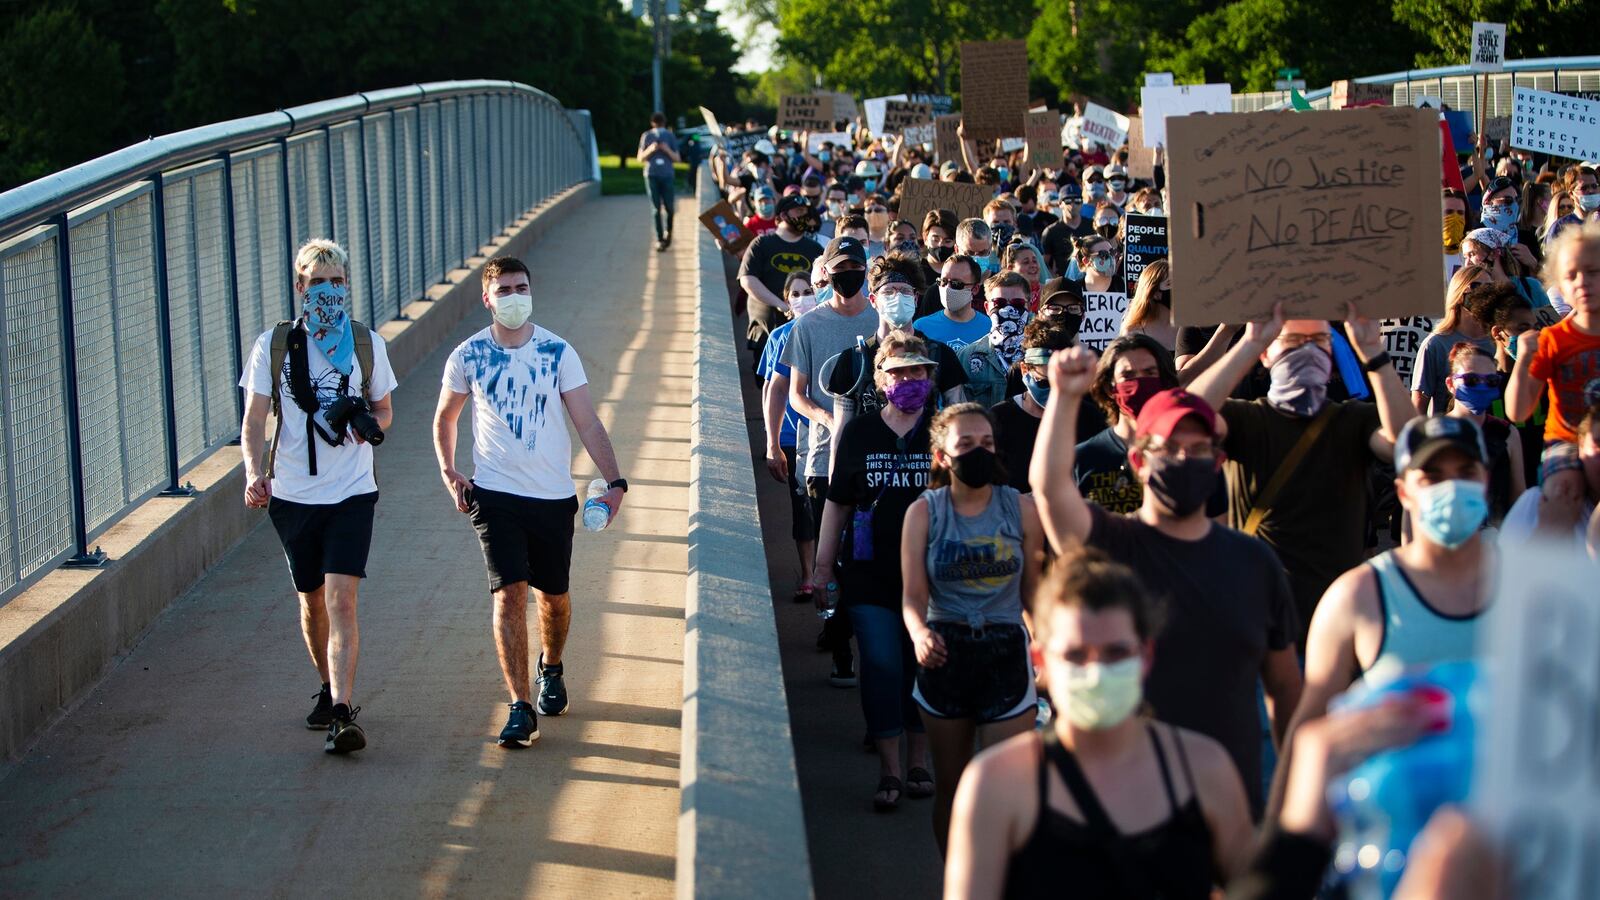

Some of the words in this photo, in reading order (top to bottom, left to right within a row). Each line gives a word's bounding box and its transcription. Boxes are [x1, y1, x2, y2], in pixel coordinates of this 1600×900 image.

[786, 97, 820, 107] BLACK
[1518, 93, 1590, 112] RESPECT
[783, 119, 830, 130] MATTER
[1516, 115, 1535, 125] OR
[1516, 126, 1578, 144] EXPECT
[1245, 157, 1292, 191] NO
[1303, 157, 1406, 188] Justice
[1128, 224, 1165, 236] PEOPLE
[1128, 234, 1141, 243] OF
[1127, 244, 1168, 255] QUALITY
[1127, 253, 1142, 263] DO
[1127, 272, 1140, 281] FE
[866, 453, 891, 461] SILENCE
[866, 461, 883, 470] THIS
[885, 461, 893, 469] IS
[866, 471, 911, 488] SPEAK
